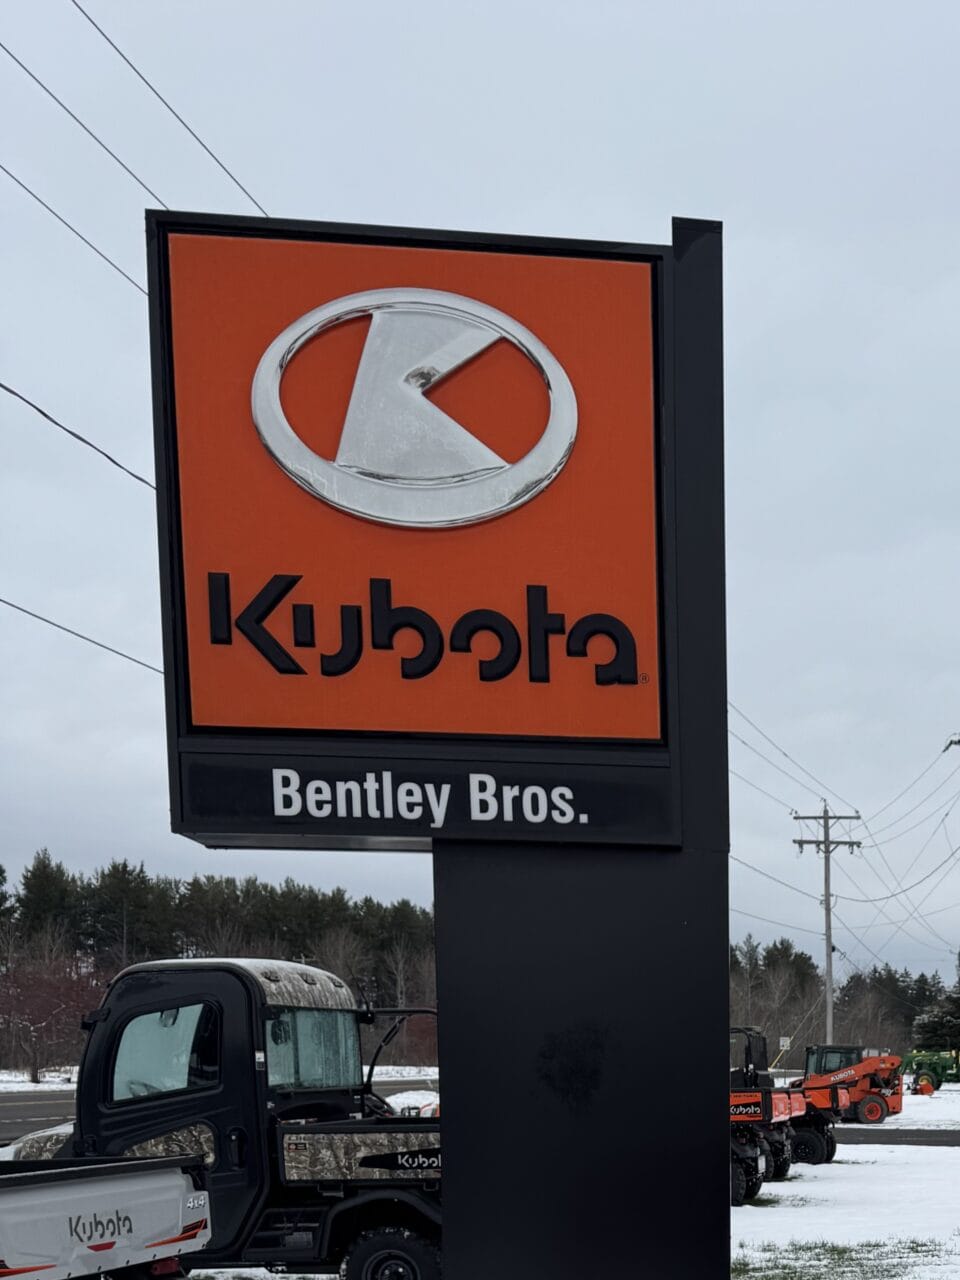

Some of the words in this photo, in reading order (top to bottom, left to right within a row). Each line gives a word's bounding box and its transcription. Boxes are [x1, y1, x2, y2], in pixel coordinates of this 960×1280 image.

[207, 571, 638, 686] Kubota
[272, 768, 451, 828] Bentley
[468, 773, 589, 824] Bros.
[68, 1208, 134, 1243] Kubota
